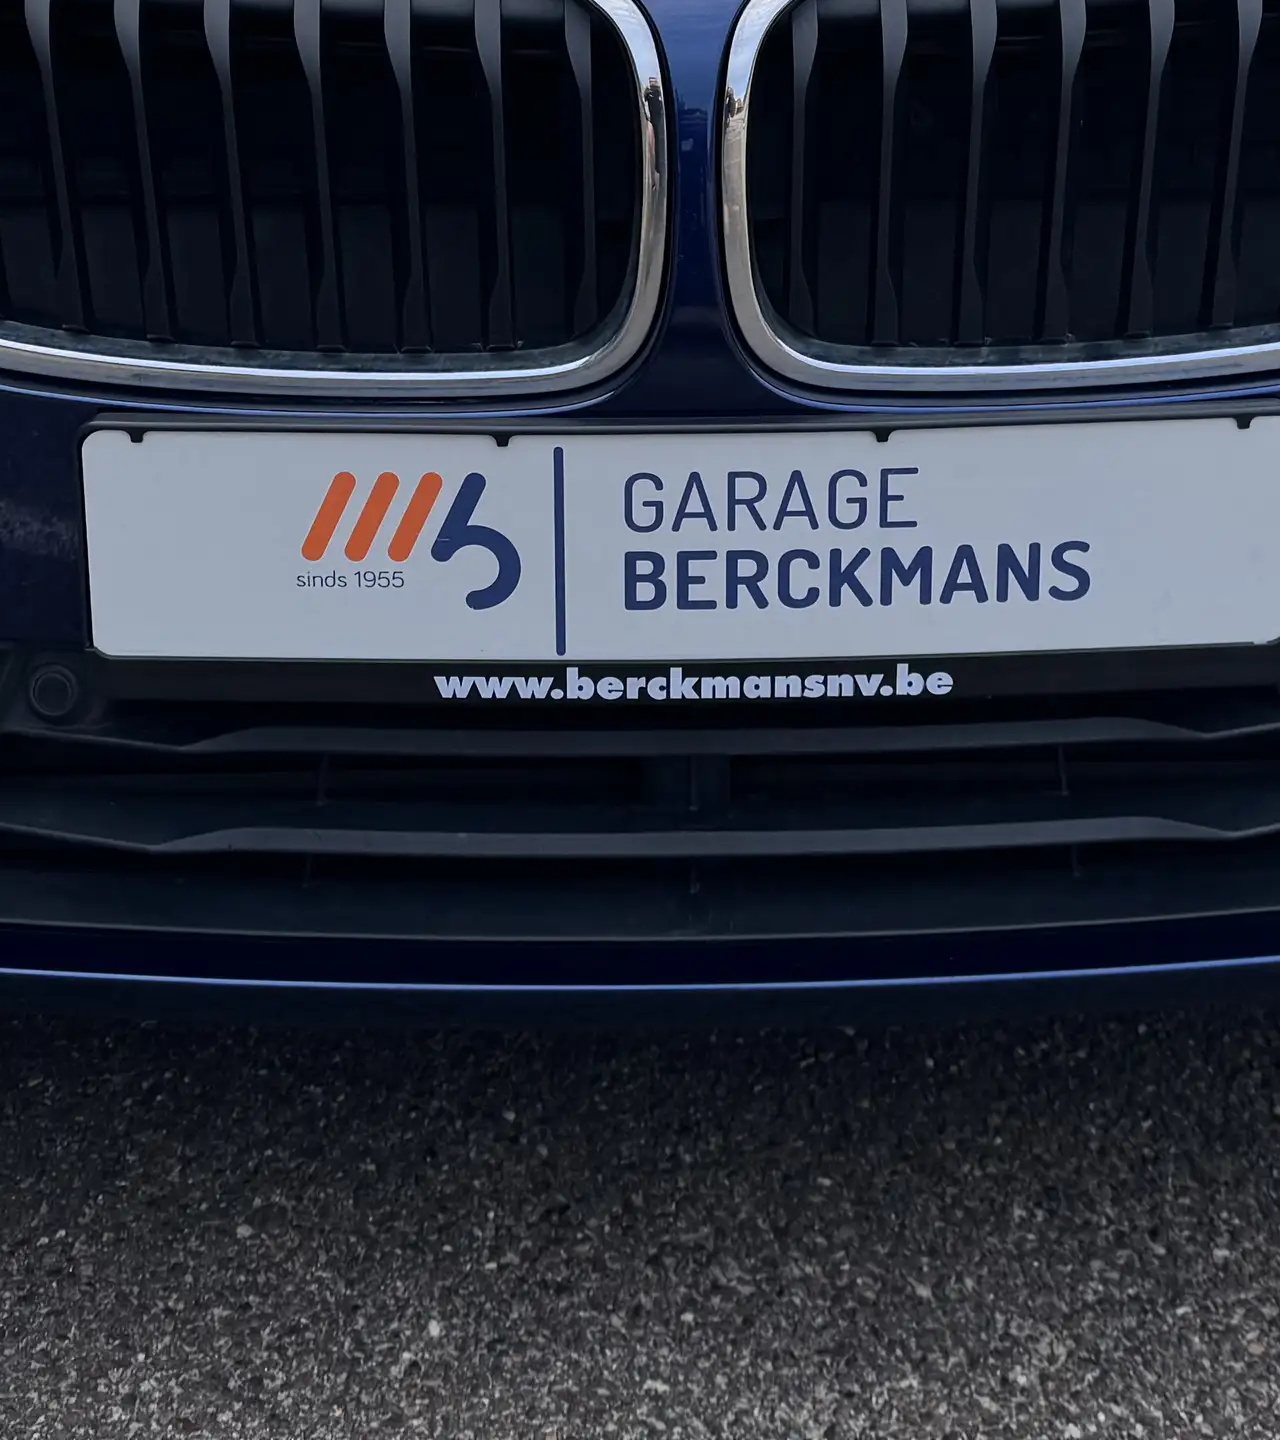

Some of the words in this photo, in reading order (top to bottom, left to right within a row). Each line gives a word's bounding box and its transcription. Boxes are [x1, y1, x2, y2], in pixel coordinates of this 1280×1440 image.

[623, 467, 919, 533] GARAGE
[296, 570, 347, 588] sinds
[354, 571, 405, 588] 1955
[624, 540, 1091, 611] BERCKMANS
[434, 664, 954, 701] www.berckmansnv.be
